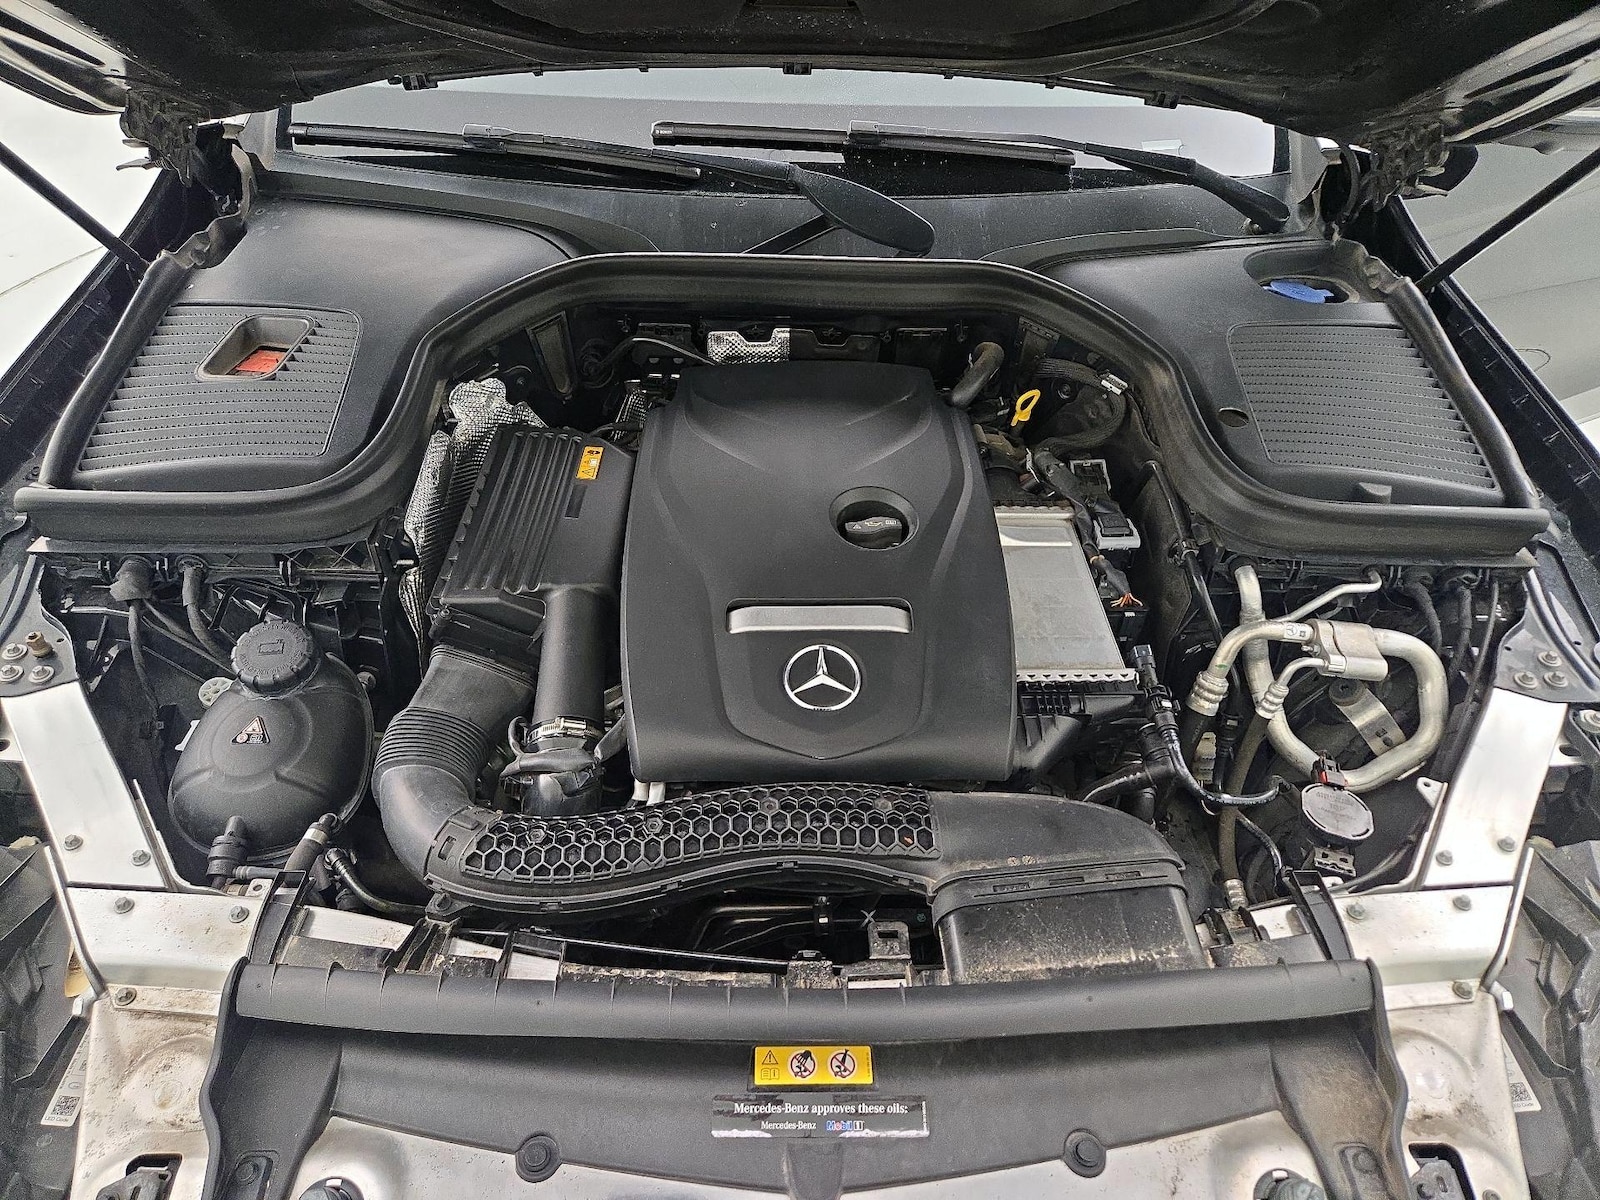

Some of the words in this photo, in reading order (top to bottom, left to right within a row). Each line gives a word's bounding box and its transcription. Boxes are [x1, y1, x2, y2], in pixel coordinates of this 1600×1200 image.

[734, 1102, 809, 1114] Mercedes-Benz
[811, 1104, 856, 1116] approves
[858, 1102, 886, 1114] these
[887, 1102, 909, 1114] oils:
[760, 1120, 817, 1130] Mercedes-Benz
[826, 1120, 853, 1131] Mobil
